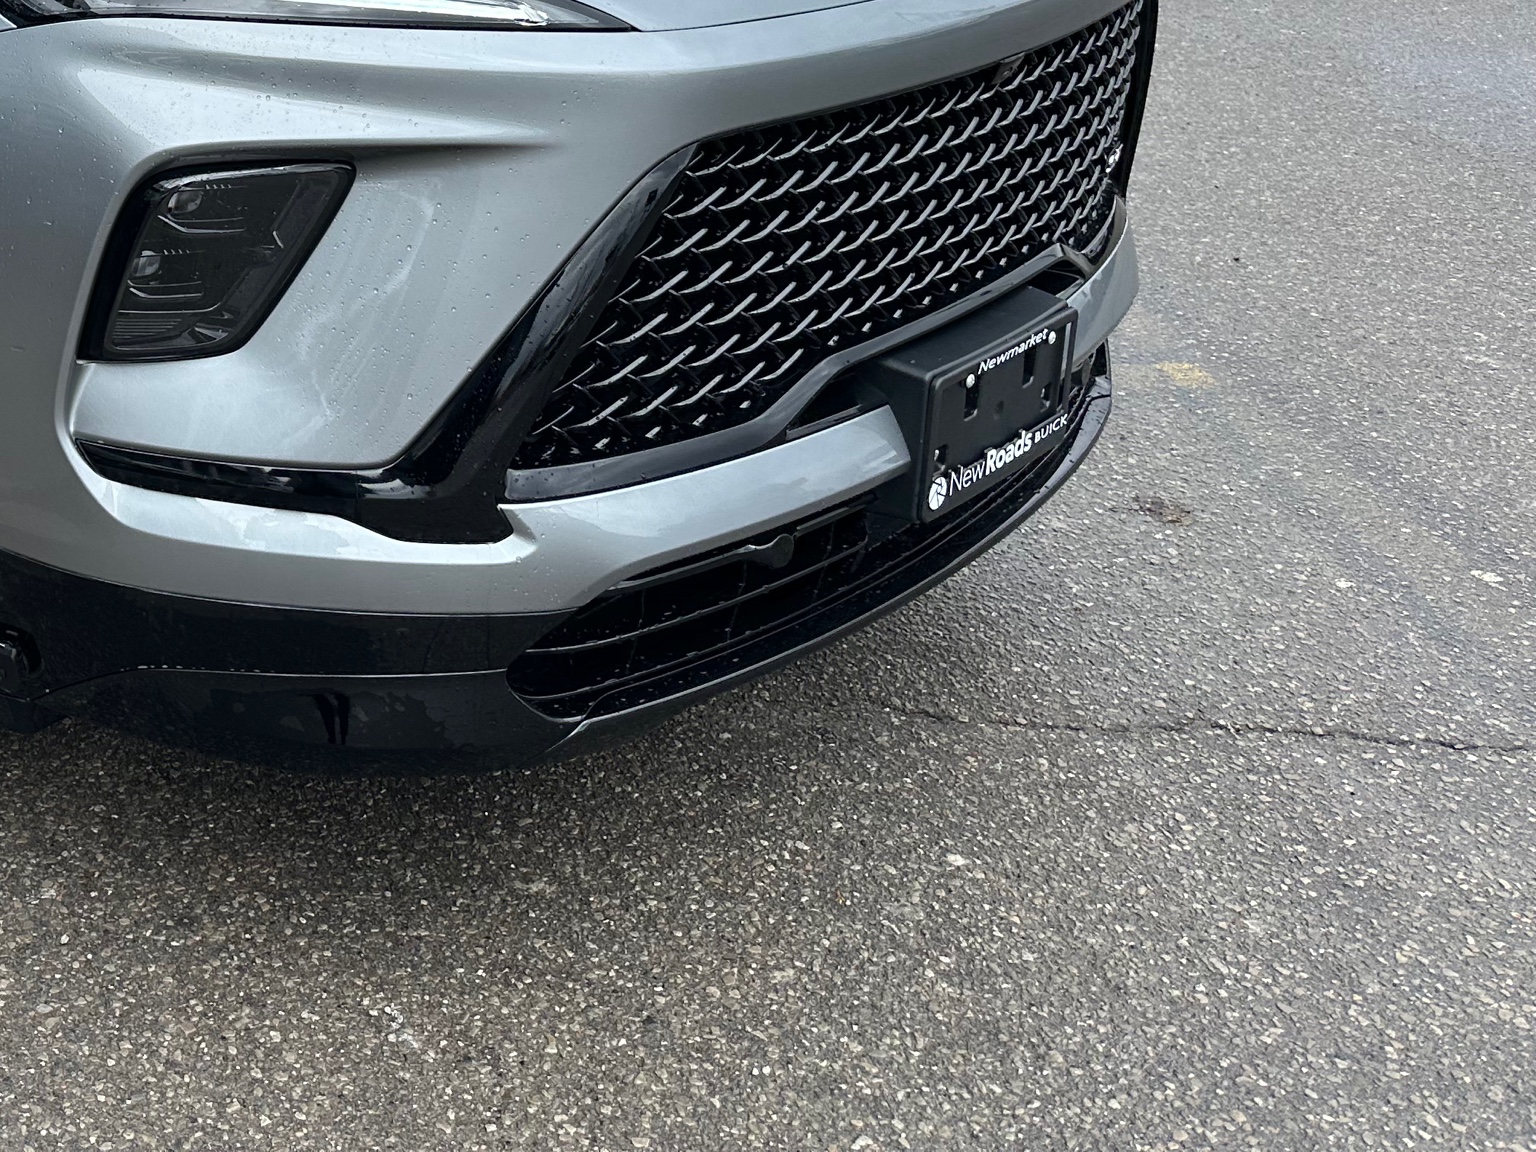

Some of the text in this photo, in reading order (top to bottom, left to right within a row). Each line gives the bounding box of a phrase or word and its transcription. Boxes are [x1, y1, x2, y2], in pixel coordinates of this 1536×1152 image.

[977, 328, 1049, 375] Newmarket
[948, 413, 1068, 497] NewRoads BUICK
